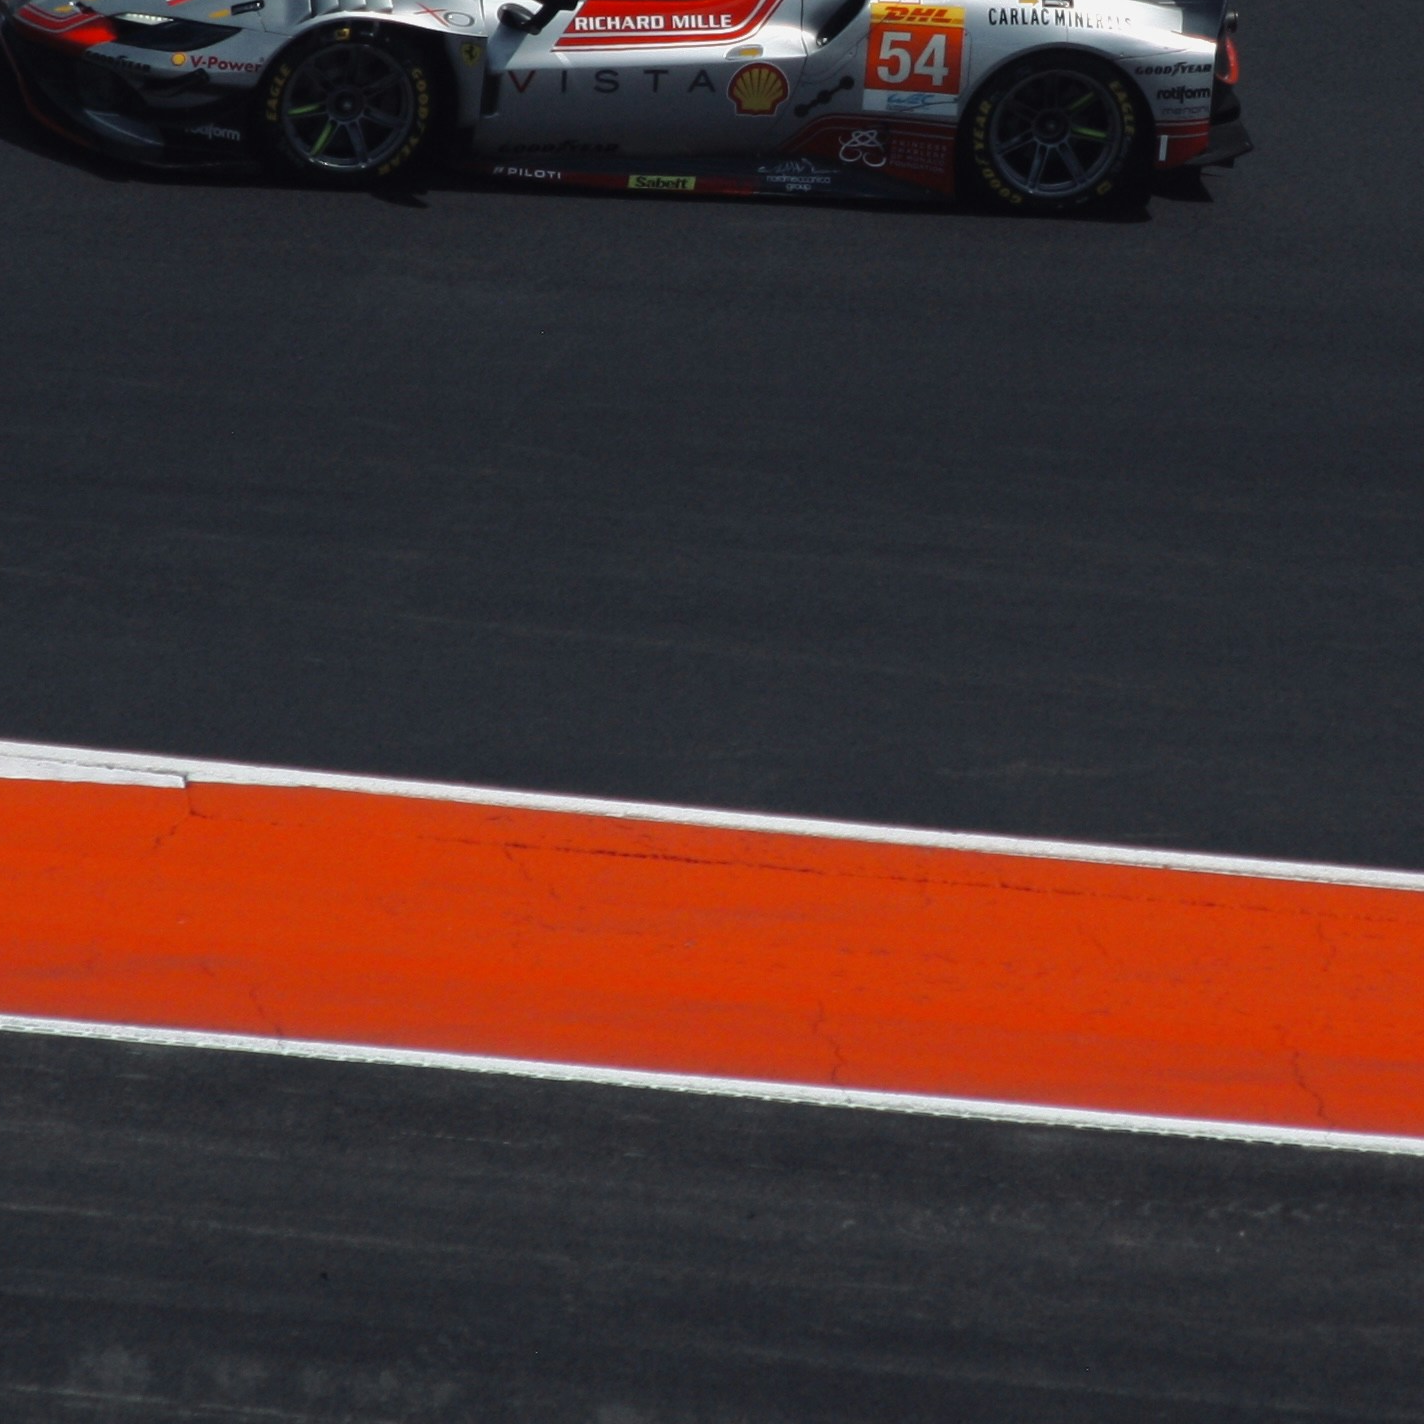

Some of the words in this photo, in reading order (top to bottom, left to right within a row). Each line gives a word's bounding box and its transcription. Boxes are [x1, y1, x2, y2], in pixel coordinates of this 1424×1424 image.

[575, 15, 664, 31] RICHARD
[672, 14, 732, 29] MILLE
[884, 6, 953, 23] DHL
[988, 7, 1050, 26] CARLAC
[189, 55, 261, 73] V-Power
[877, 31, 950, 87] 54
[1134, 61, 1213, 76] GOODYEAR
[508, 69, 716, 93] VISTA
[266, 63, 292, 122] EAGLE
[1157, 85, 1210, 104] rotiform
[1108, 80, 1136, 137] EAGLE
[377, 67, 430, 176] GOODYEAR
[184, 122, 241, 142] oform
[973, 99, 1024, 204] GOODYEAR
[507, 166, 562, 180] PILOTI
